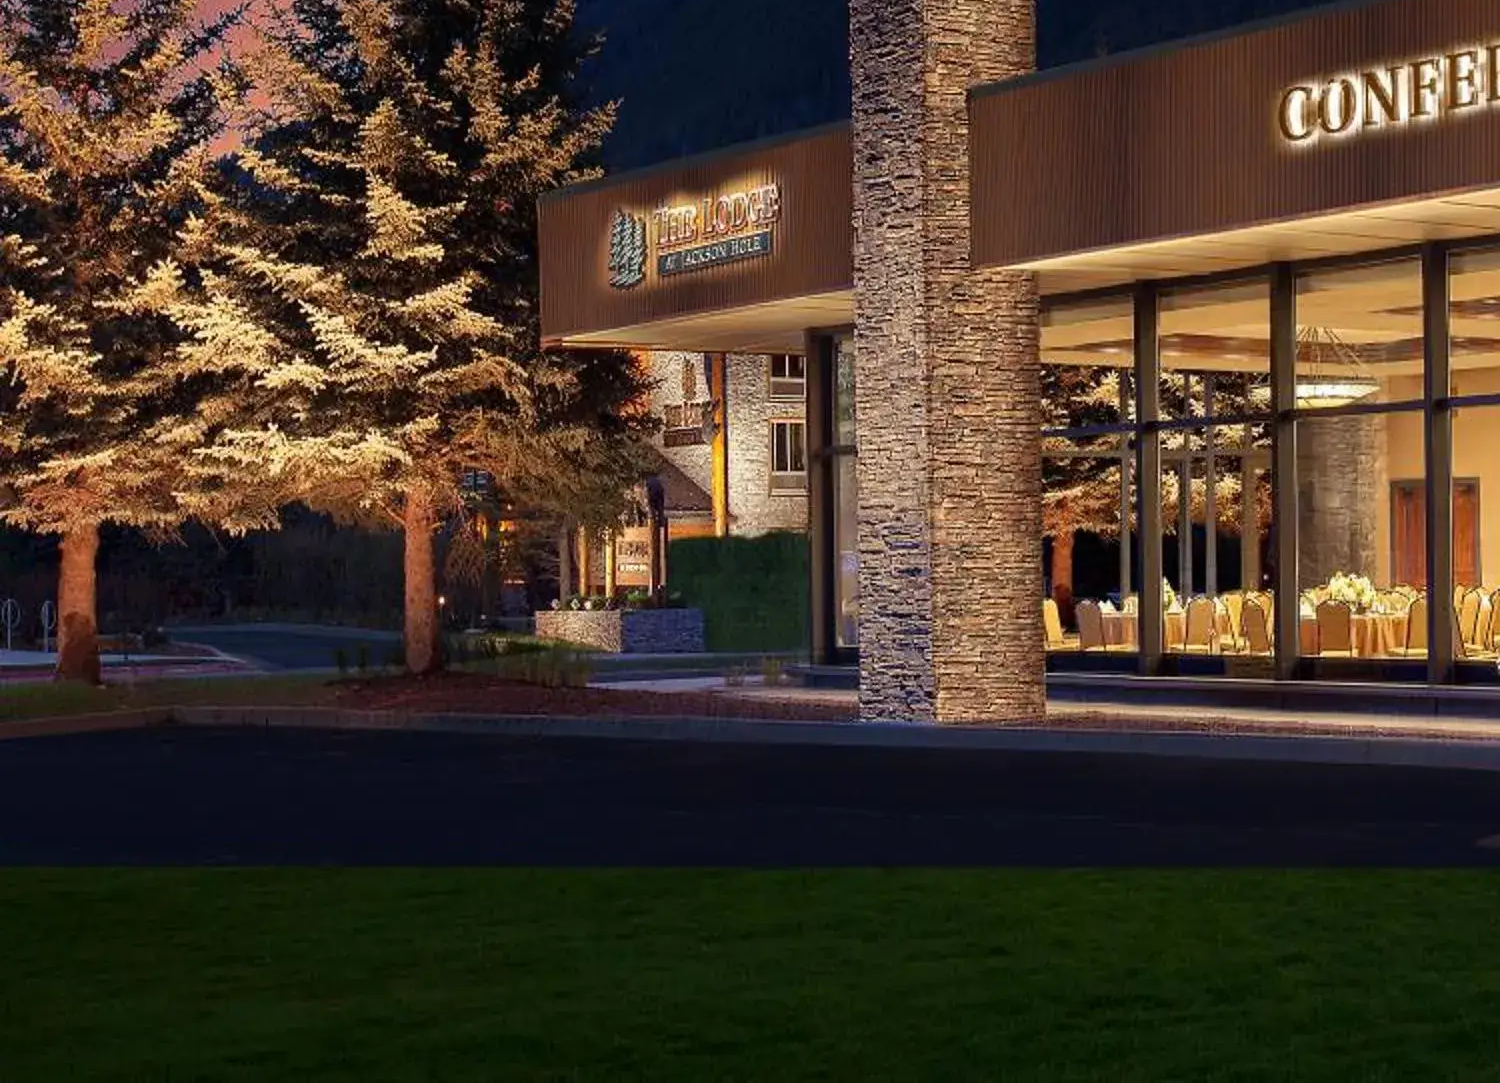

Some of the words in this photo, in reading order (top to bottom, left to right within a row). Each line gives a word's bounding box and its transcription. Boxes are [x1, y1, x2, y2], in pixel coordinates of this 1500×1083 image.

[653, 205, 697, 246] THE
[701, 185, 779, 237] LODGE
[730, 236, 762, 255] HOLE
